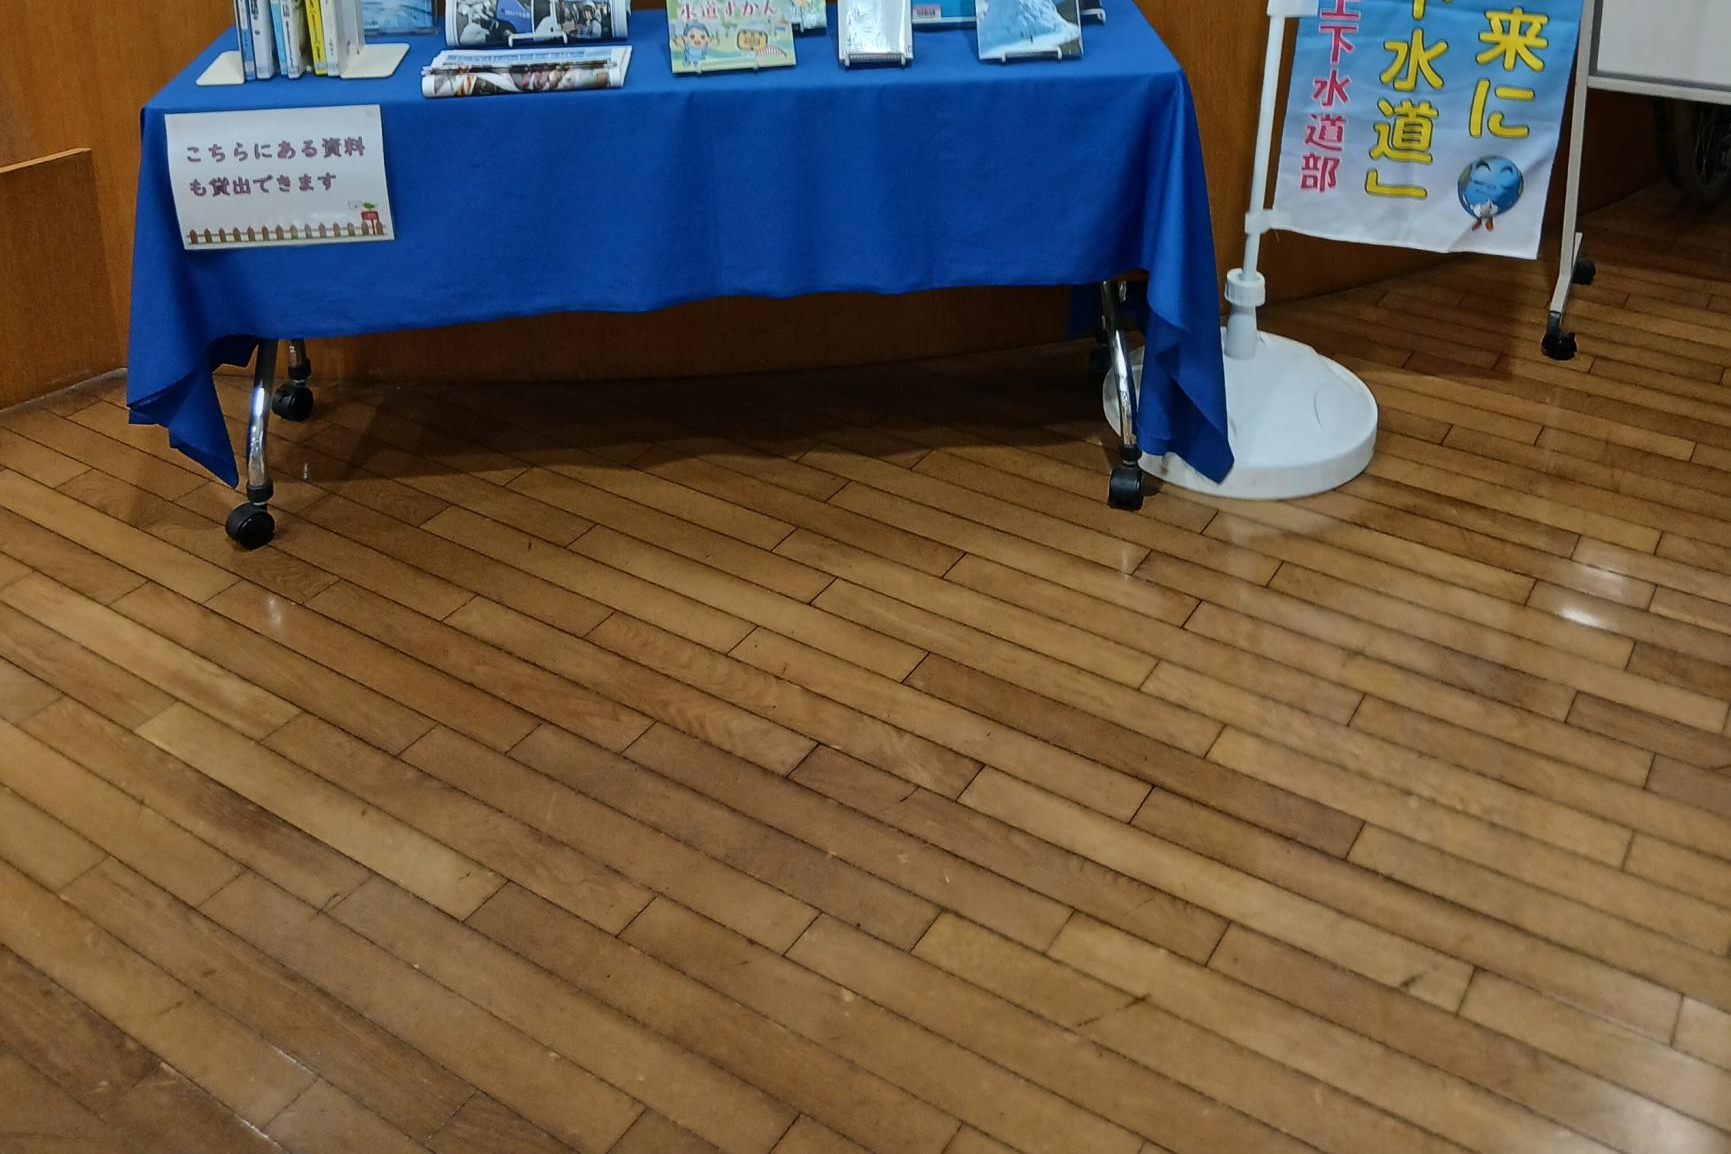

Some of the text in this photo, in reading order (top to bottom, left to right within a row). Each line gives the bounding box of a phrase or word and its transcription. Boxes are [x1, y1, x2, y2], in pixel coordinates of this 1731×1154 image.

[186, 136, 366, 163] こちらにある資料
[189, 172, 337, 197] も貸出できます
